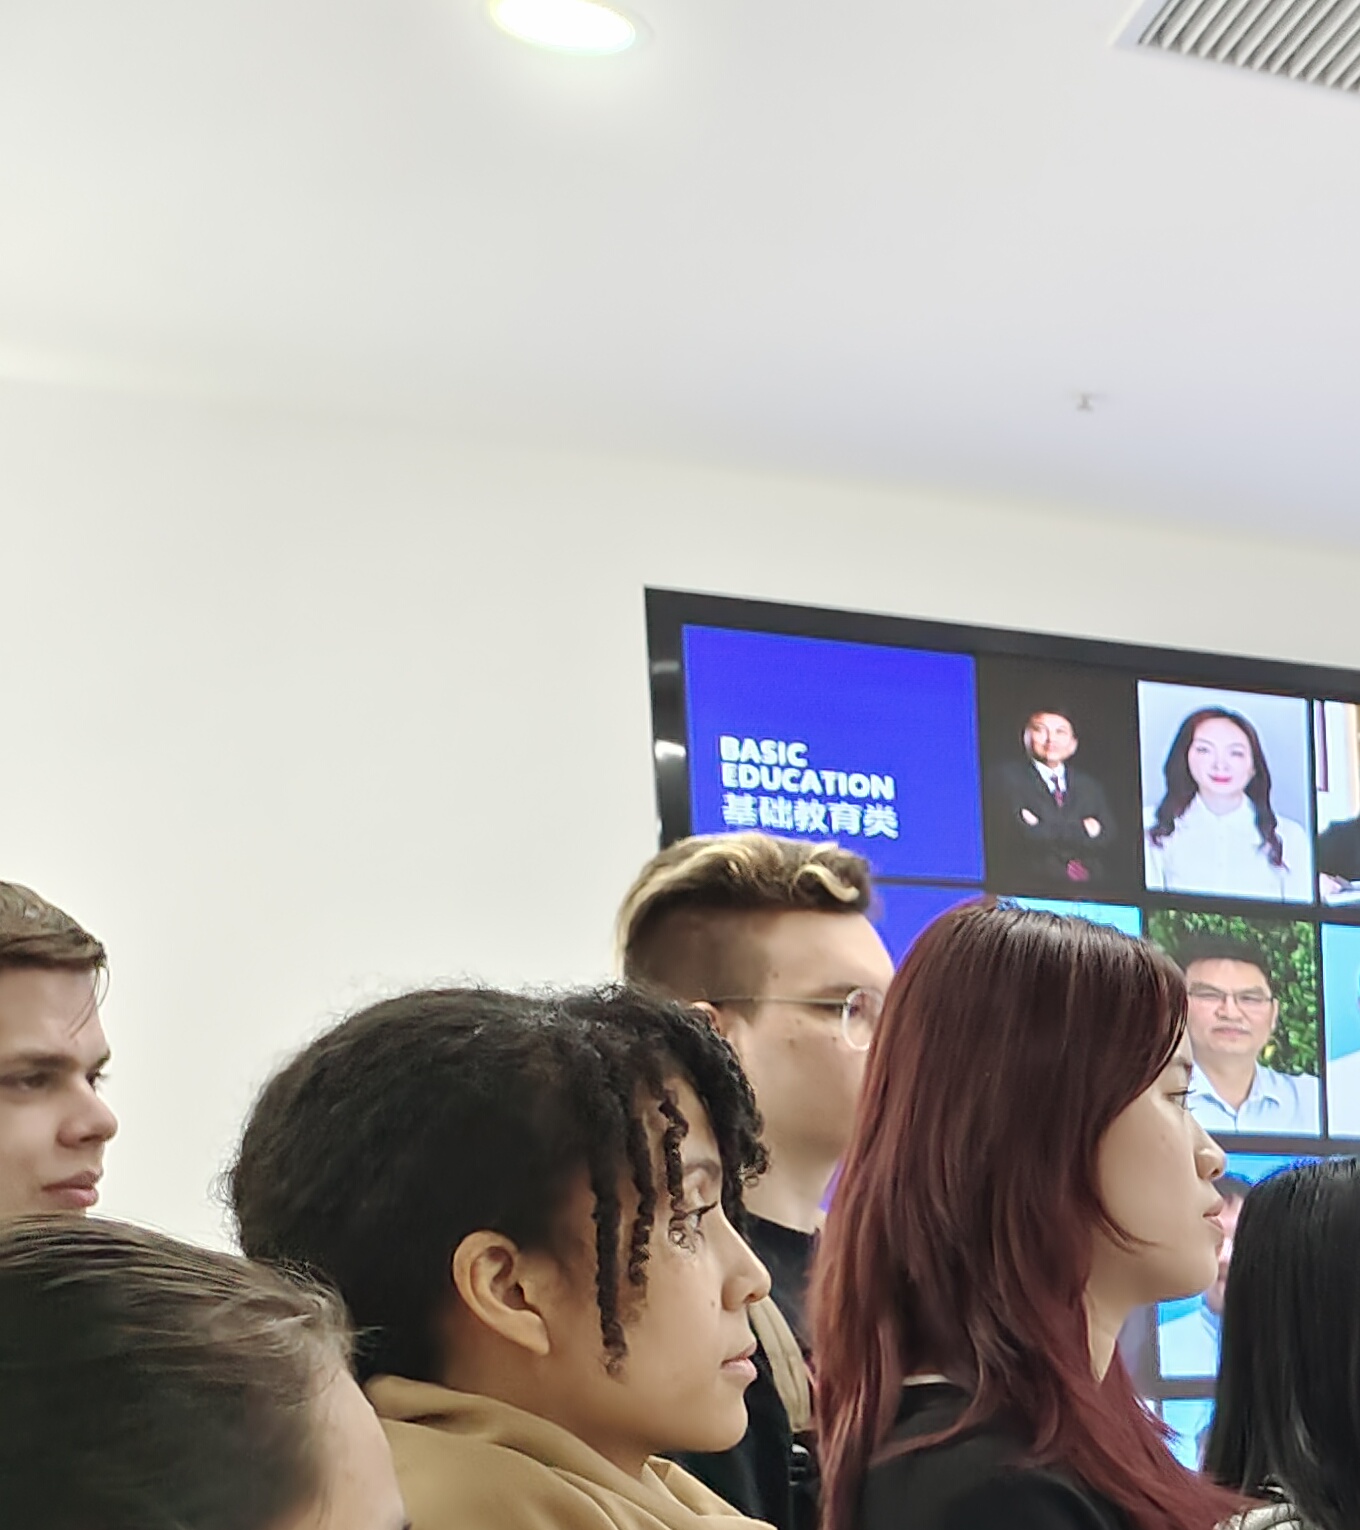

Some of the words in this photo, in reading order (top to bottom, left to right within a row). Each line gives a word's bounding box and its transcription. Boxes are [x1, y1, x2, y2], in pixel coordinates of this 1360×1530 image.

[719, 735, 809, 768] BASIC
[721, 762, 896, 800] EDUCATION
[722, 792, 899, 840] 基础教育类
